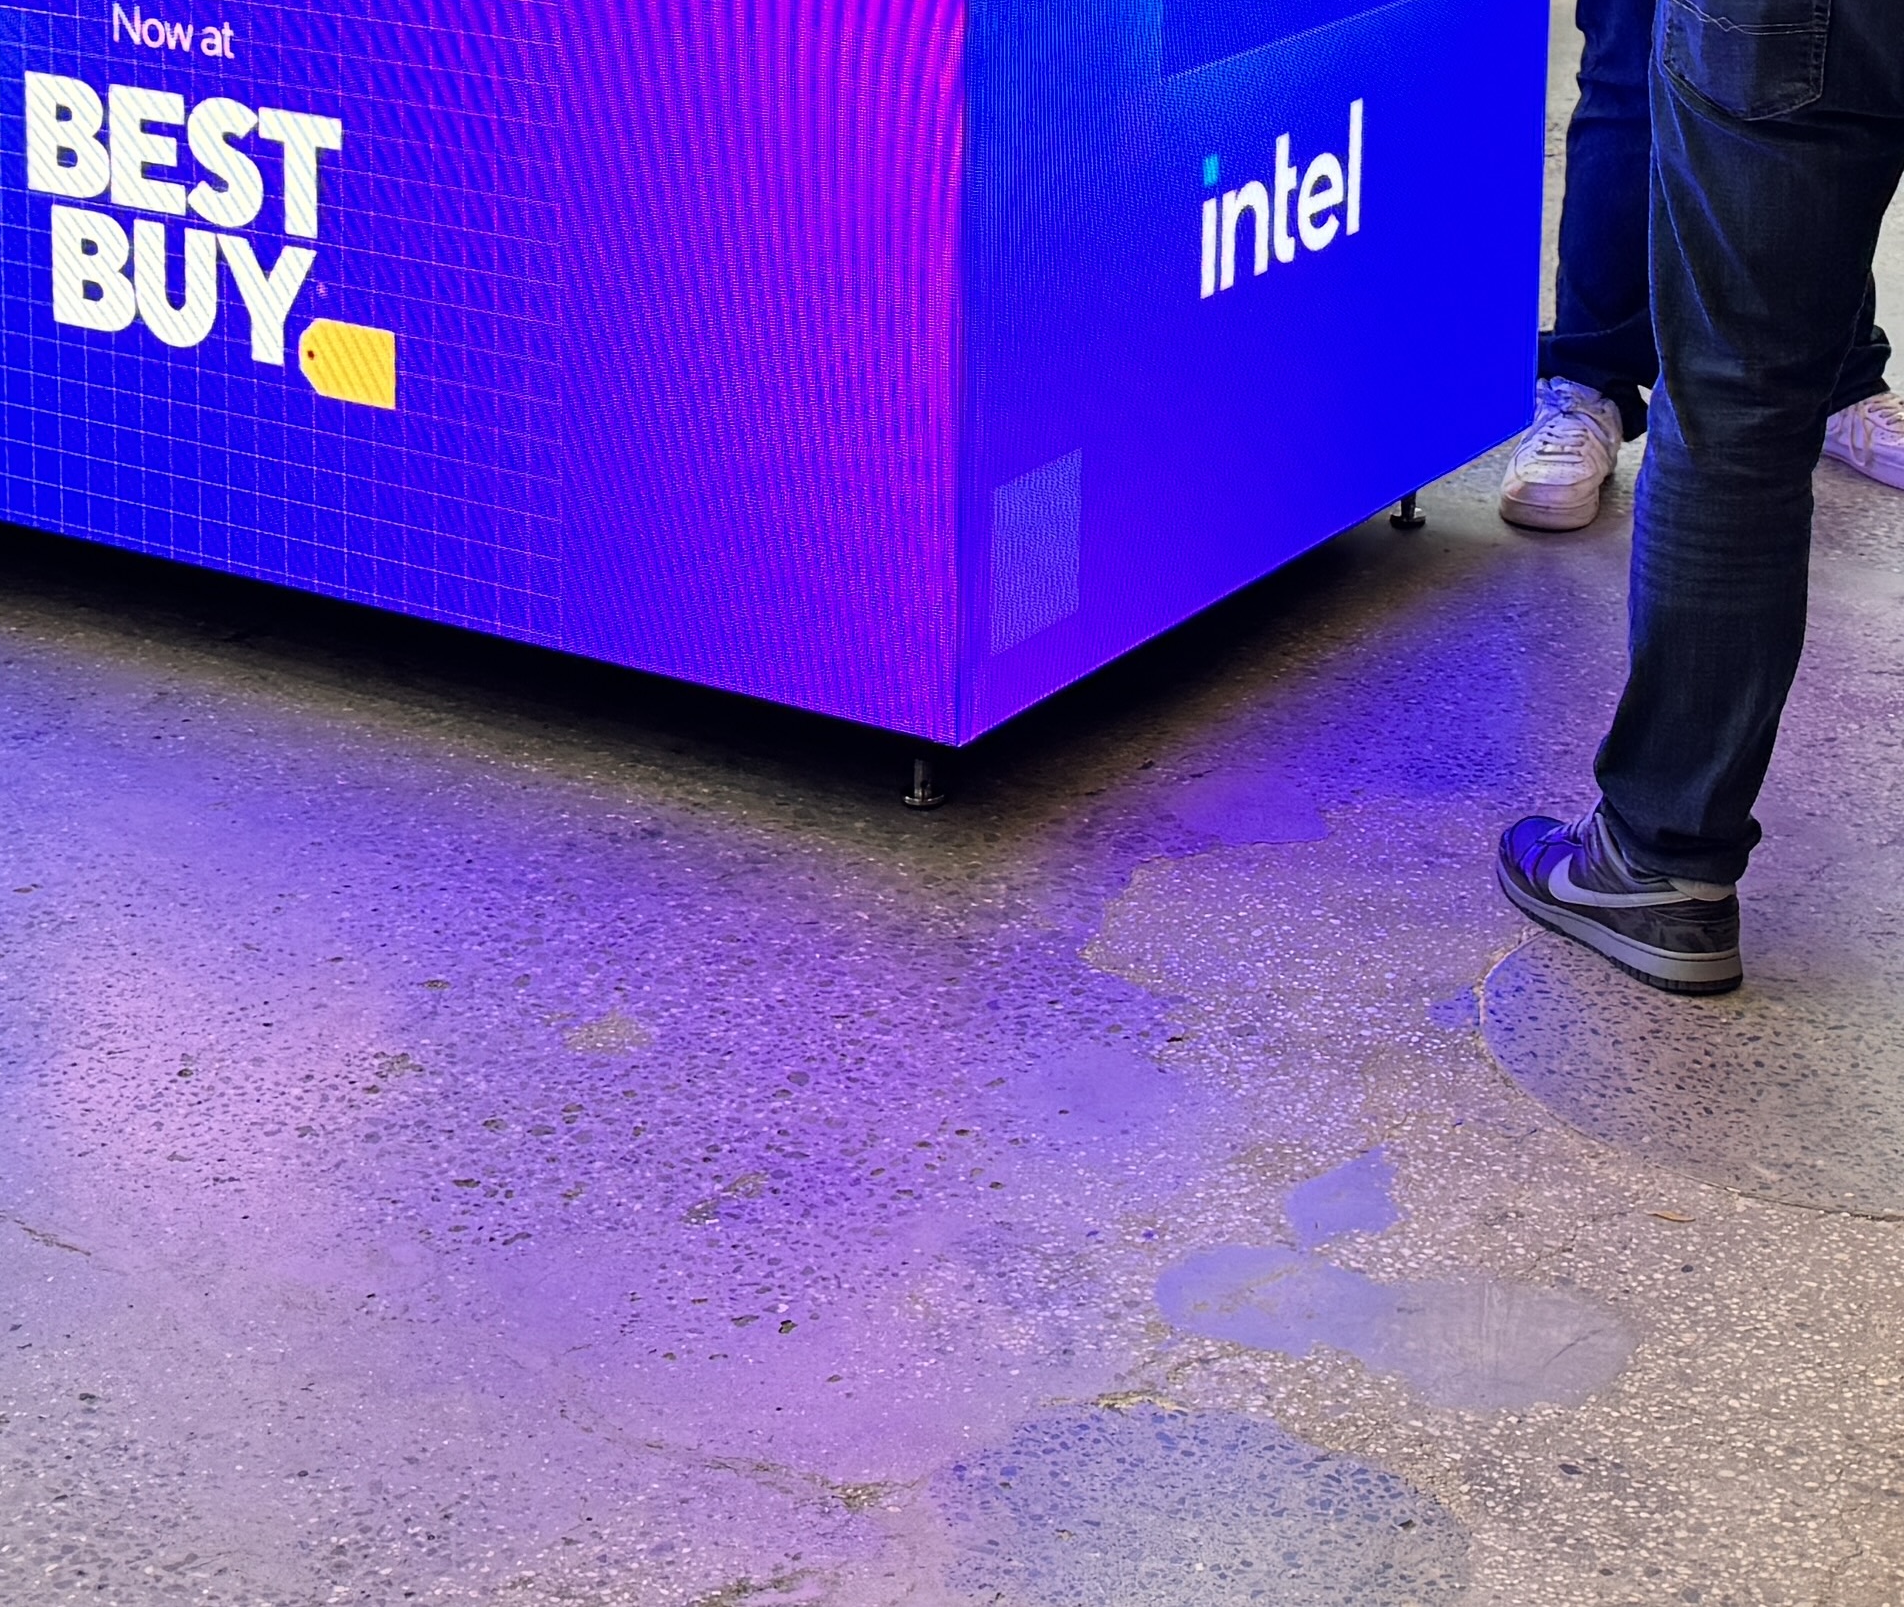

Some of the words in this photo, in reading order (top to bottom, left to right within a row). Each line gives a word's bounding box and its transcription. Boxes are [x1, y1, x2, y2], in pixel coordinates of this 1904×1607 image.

[112, 2, 193, 51] Now
[200, 21, 234, 58] at
[24, 70, 342, 240] BEST
[1200, 98, 1363, 299] intel
[51, 204, 317, 367] BUY
